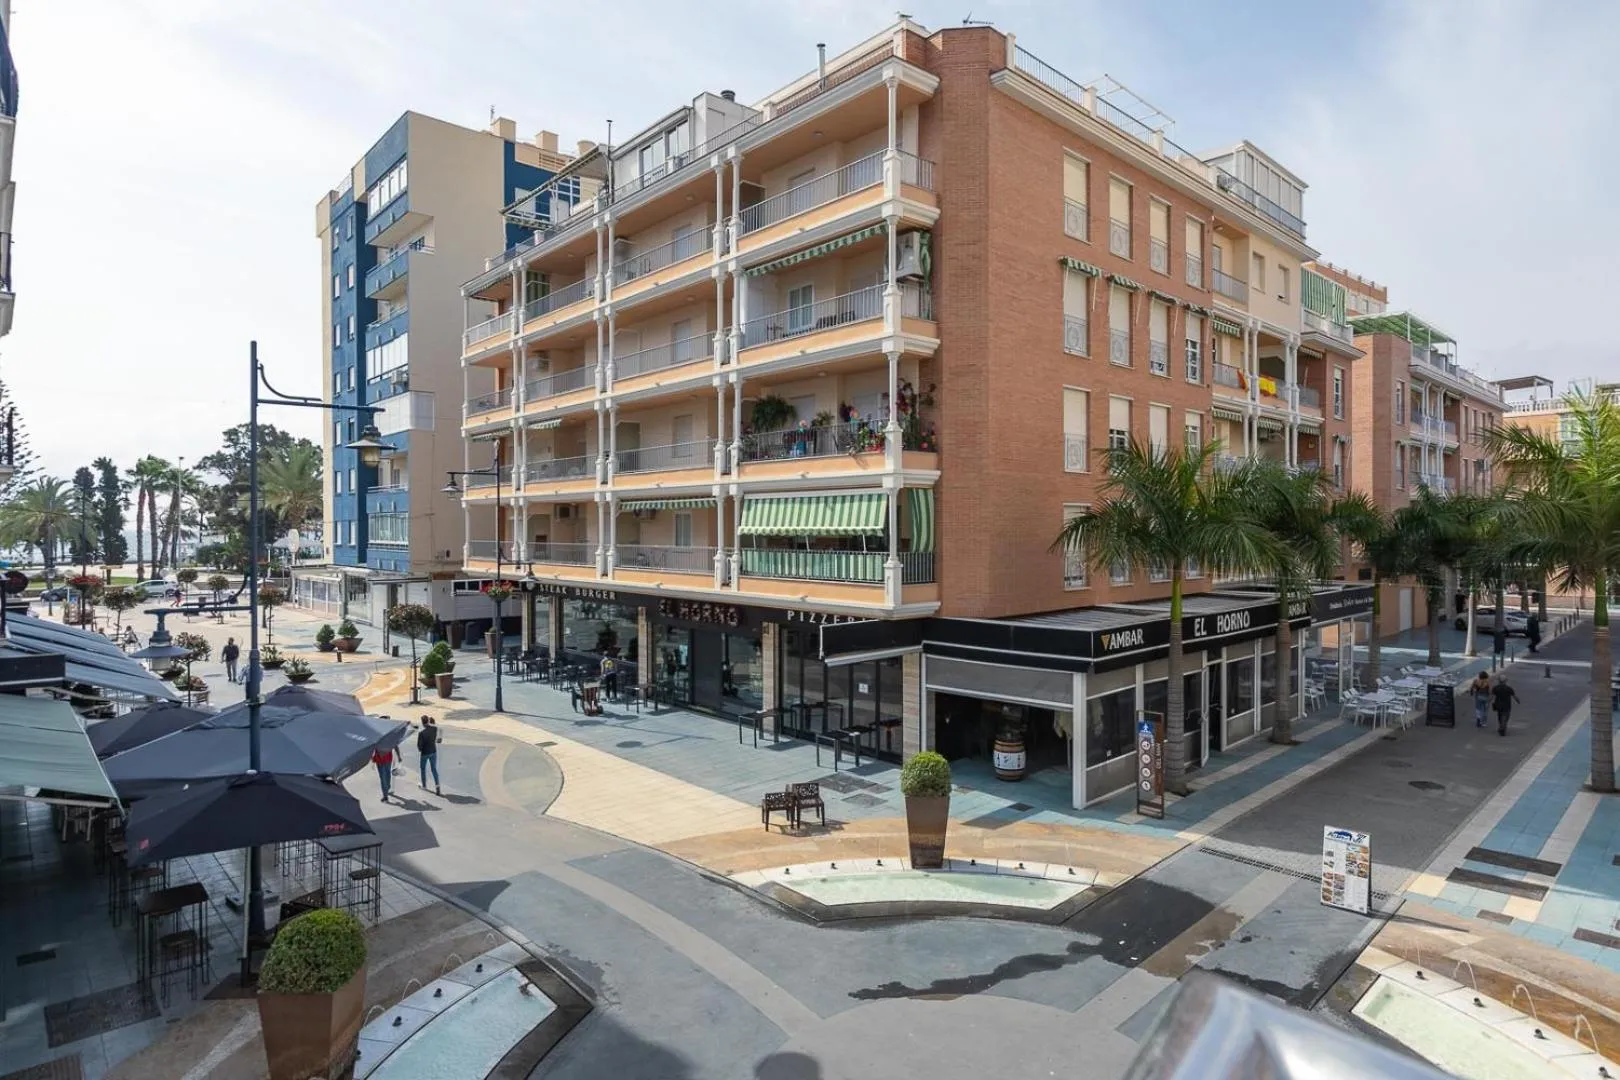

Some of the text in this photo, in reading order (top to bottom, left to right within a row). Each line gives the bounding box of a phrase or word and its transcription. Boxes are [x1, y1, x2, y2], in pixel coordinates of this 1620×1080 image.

[575, 587, 616, 600] BURGER
[680, 602, 738, 627] HORNO
[1194, 611, 1250, 637] EL HORNO
[1109, 628, 1144, 650] AMBAR
